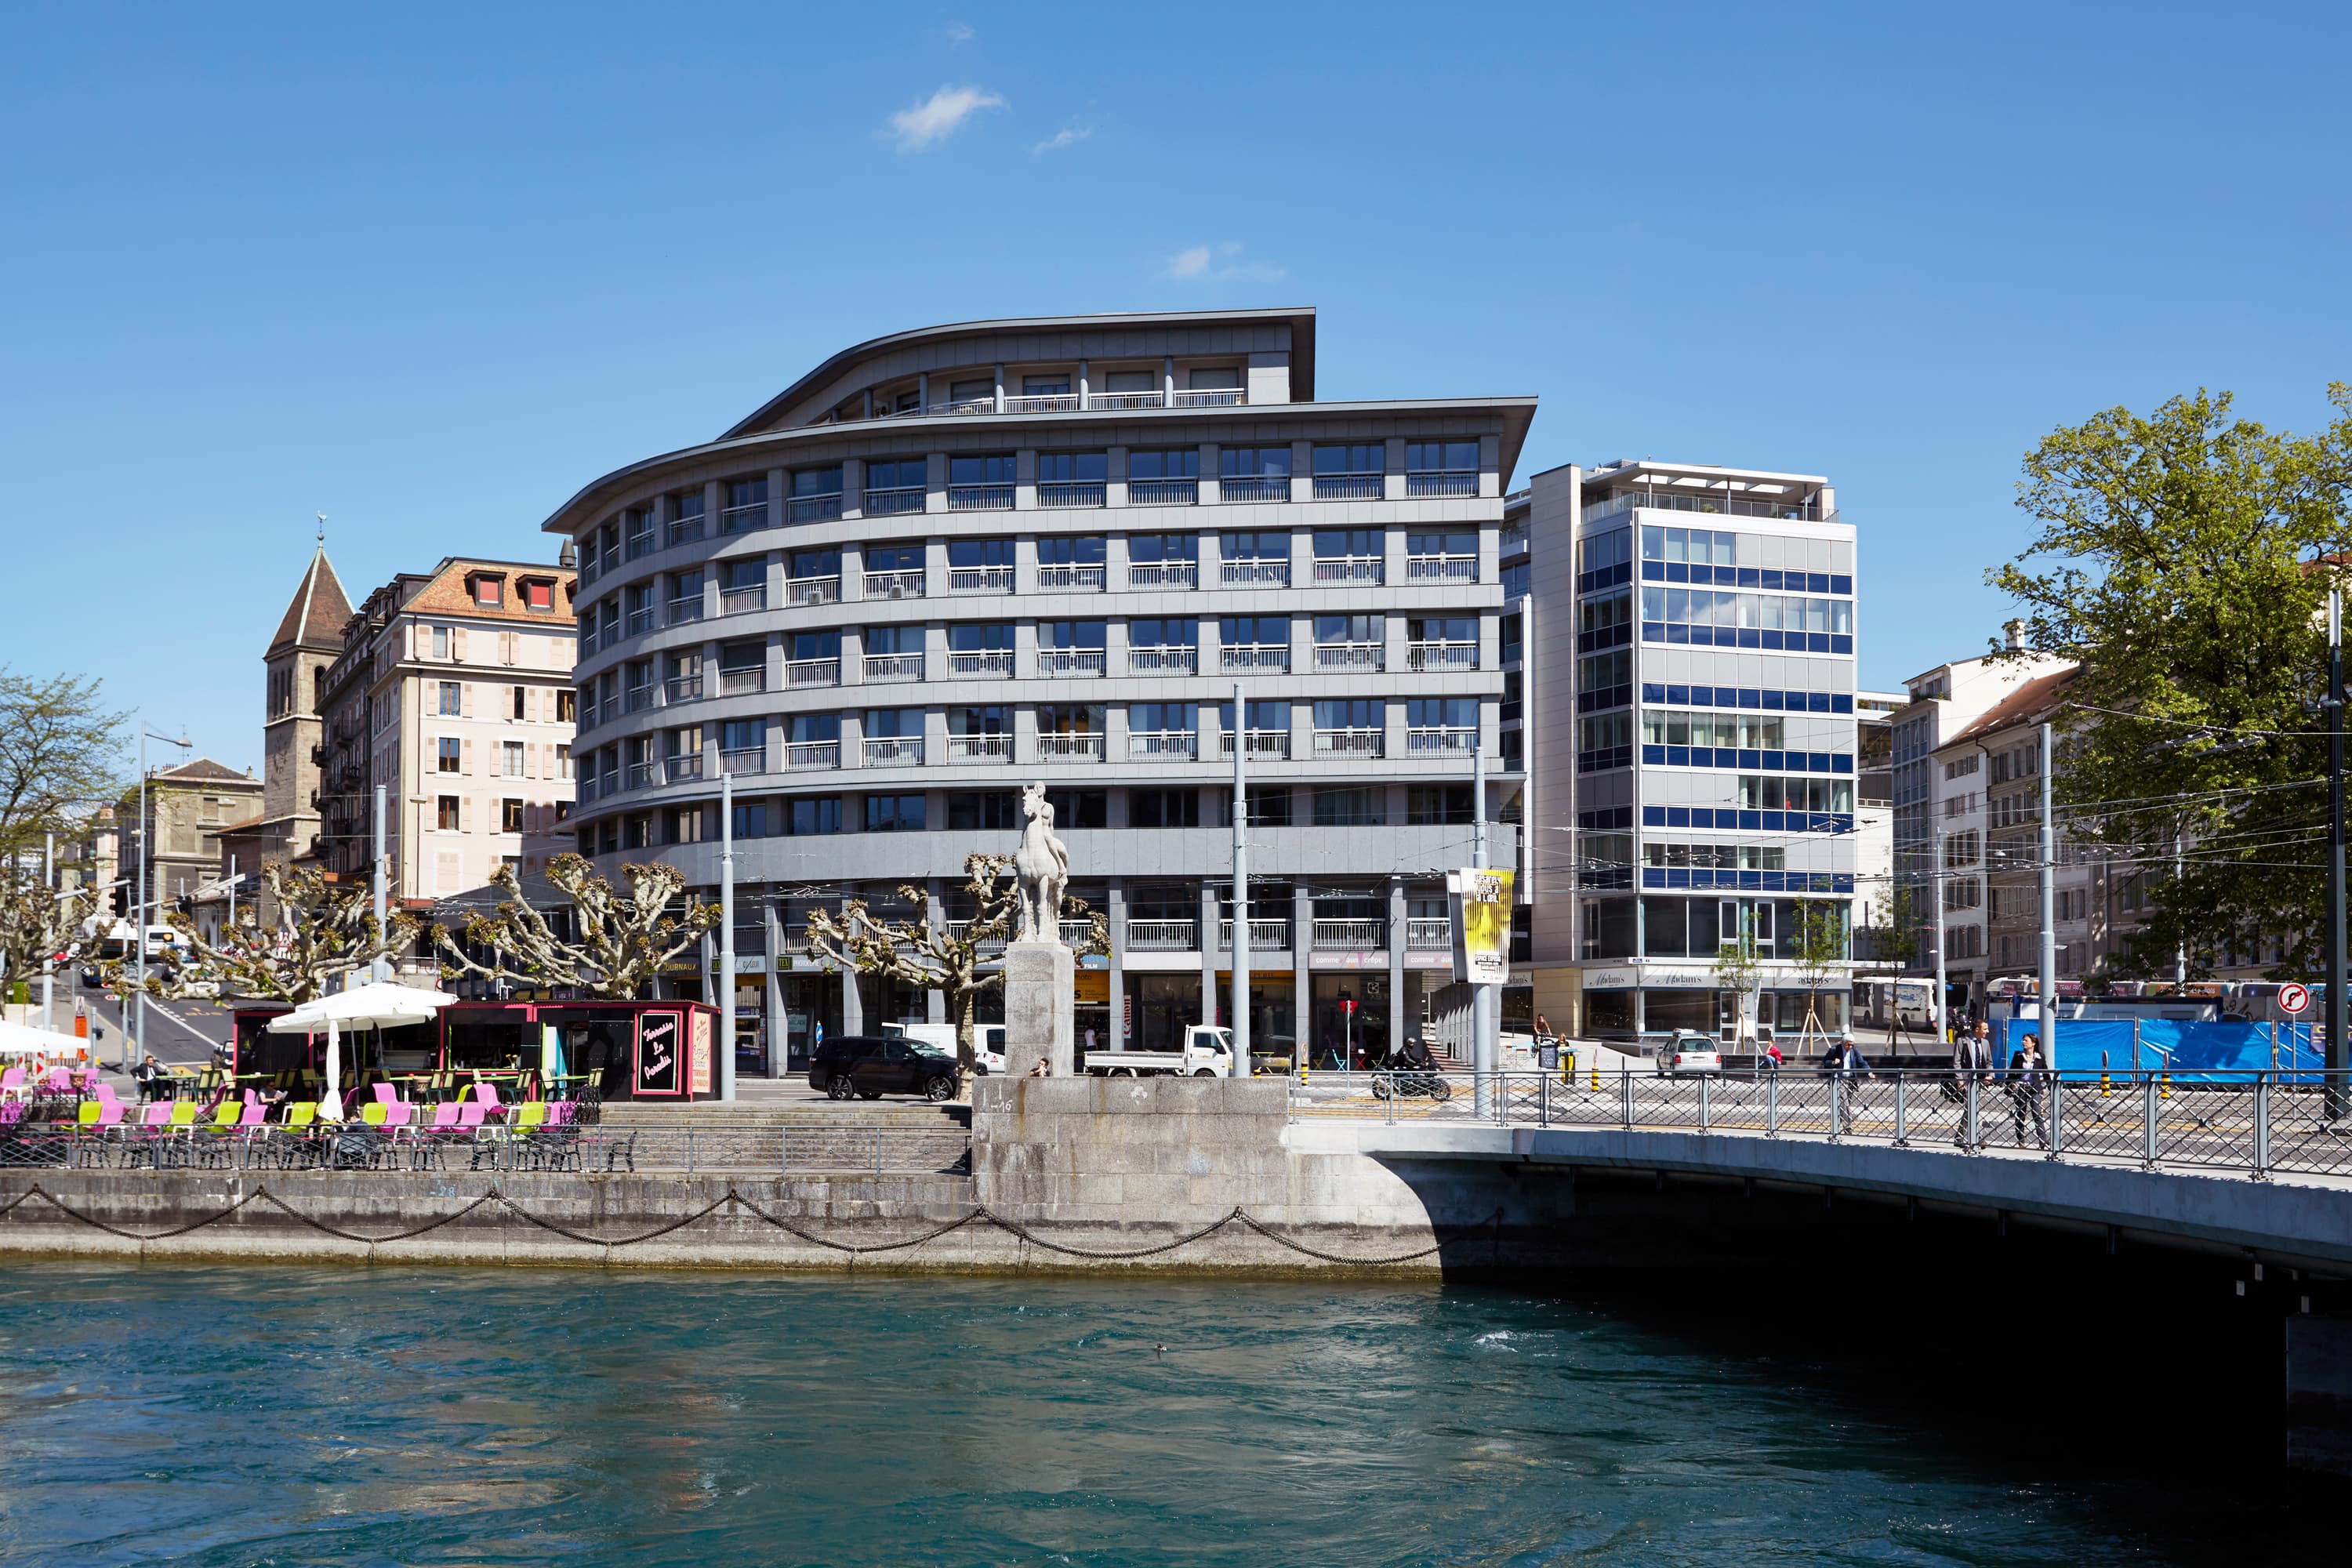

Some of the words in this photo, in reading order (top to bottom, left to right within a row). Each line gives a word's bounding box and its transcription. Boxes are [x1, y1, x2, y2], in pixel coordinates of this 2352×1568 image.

[642, 1022, 674, 1042] Terrasse
[653, 1041, 665, 1055] Le
[644, 1054, 672, 1080] Paradis
